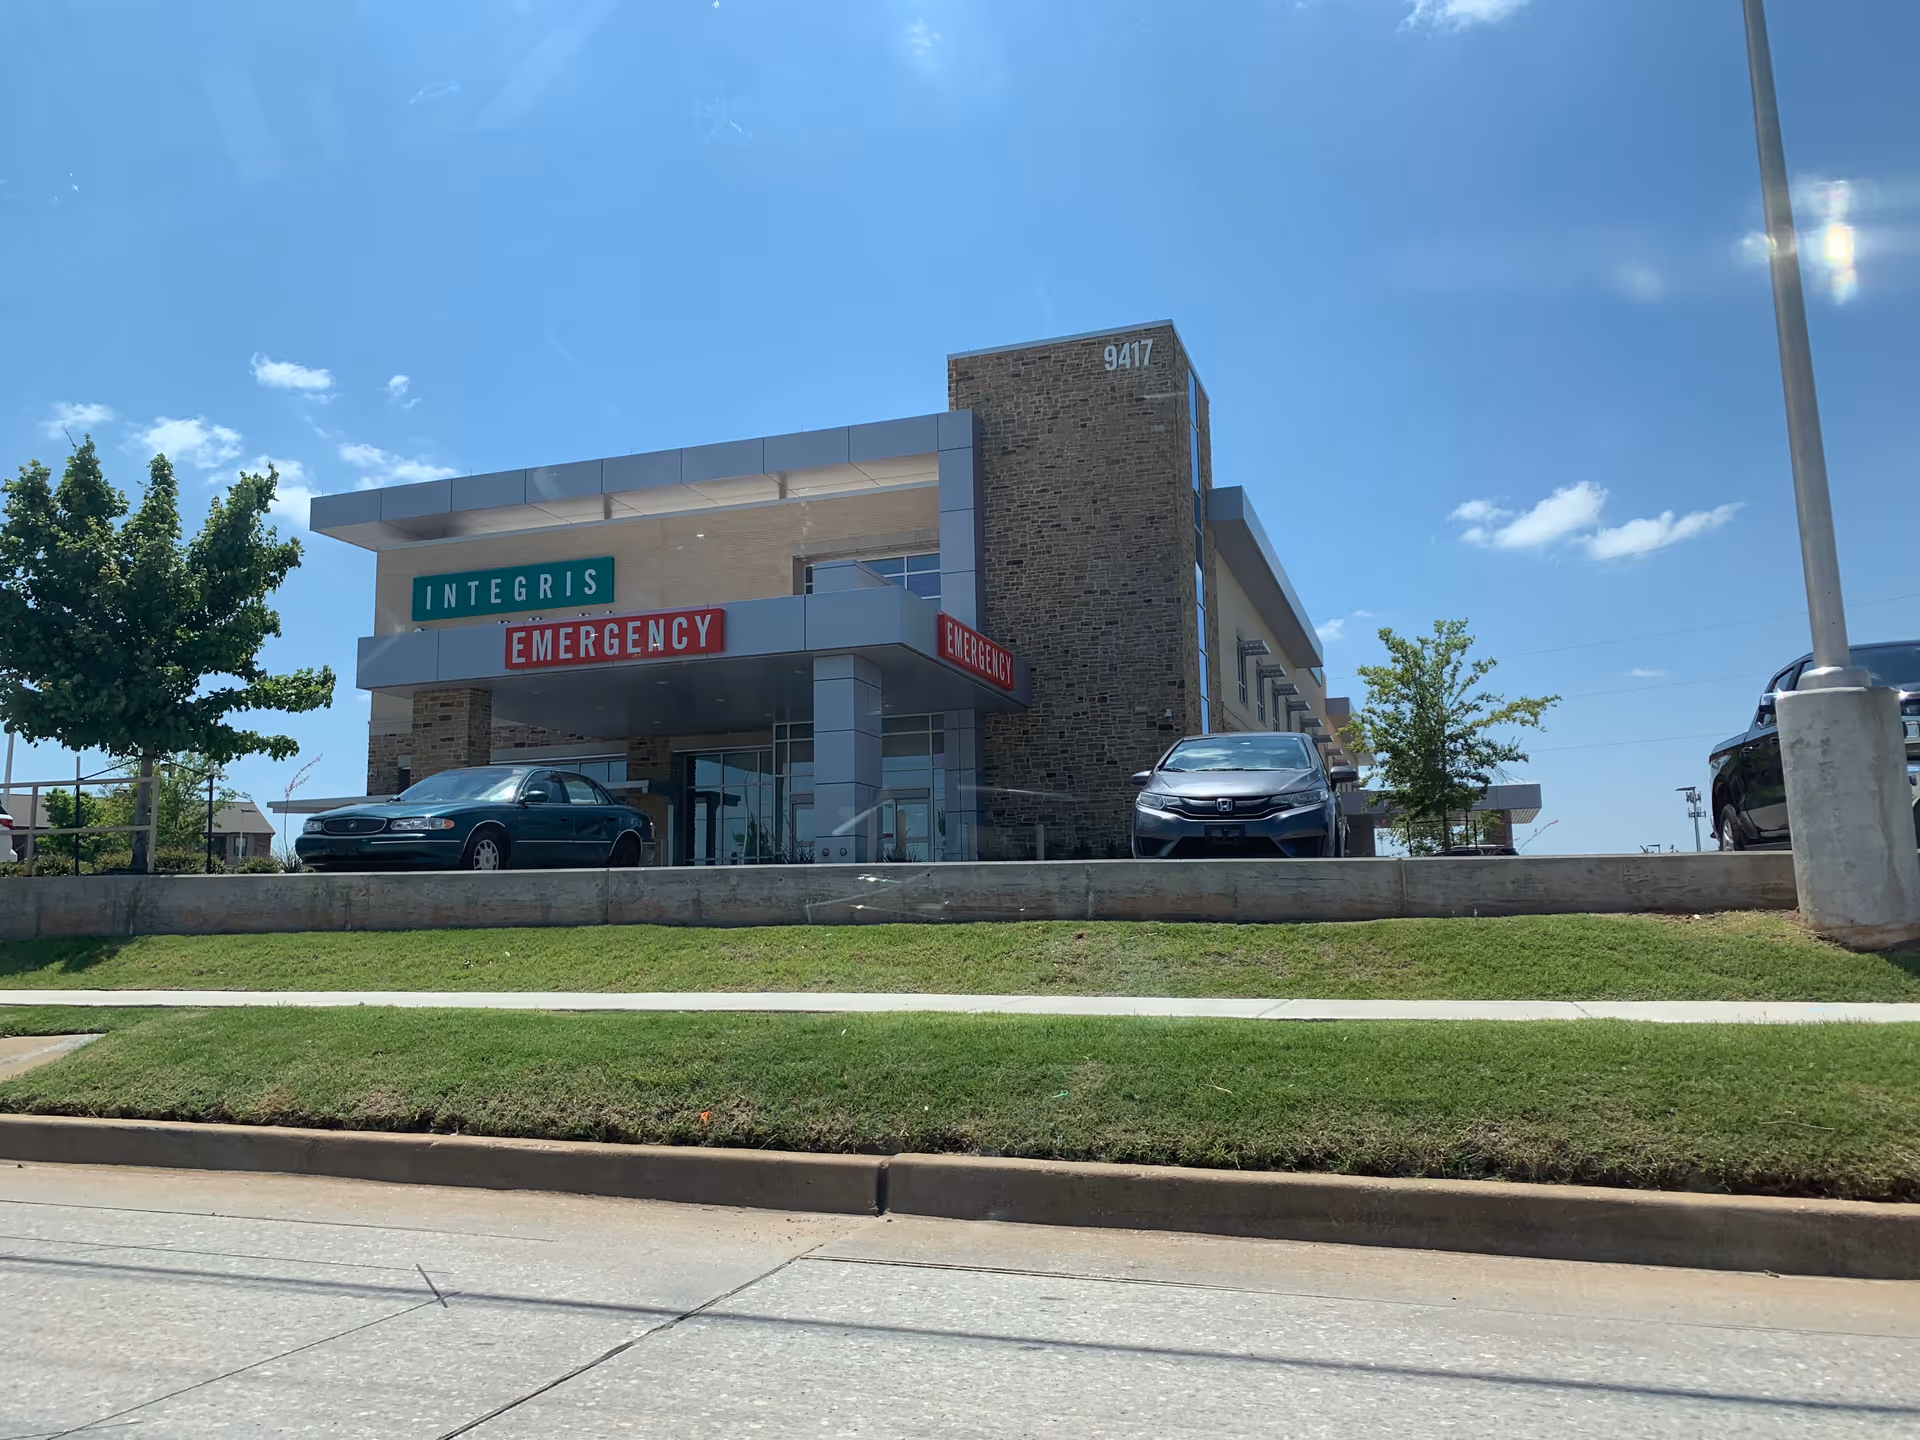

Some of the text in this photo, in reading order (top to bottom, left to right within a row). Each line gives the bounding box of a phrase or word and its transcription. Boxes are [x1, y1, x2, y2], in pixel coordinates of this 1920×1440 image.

[1104, 339, 1153, 371] 9417
[426, 569, 597, 610] INTEGRIS
[511, 615, 711, 664] EMERGENCY
[947, 621, 1011, 685] EMERGENCY
